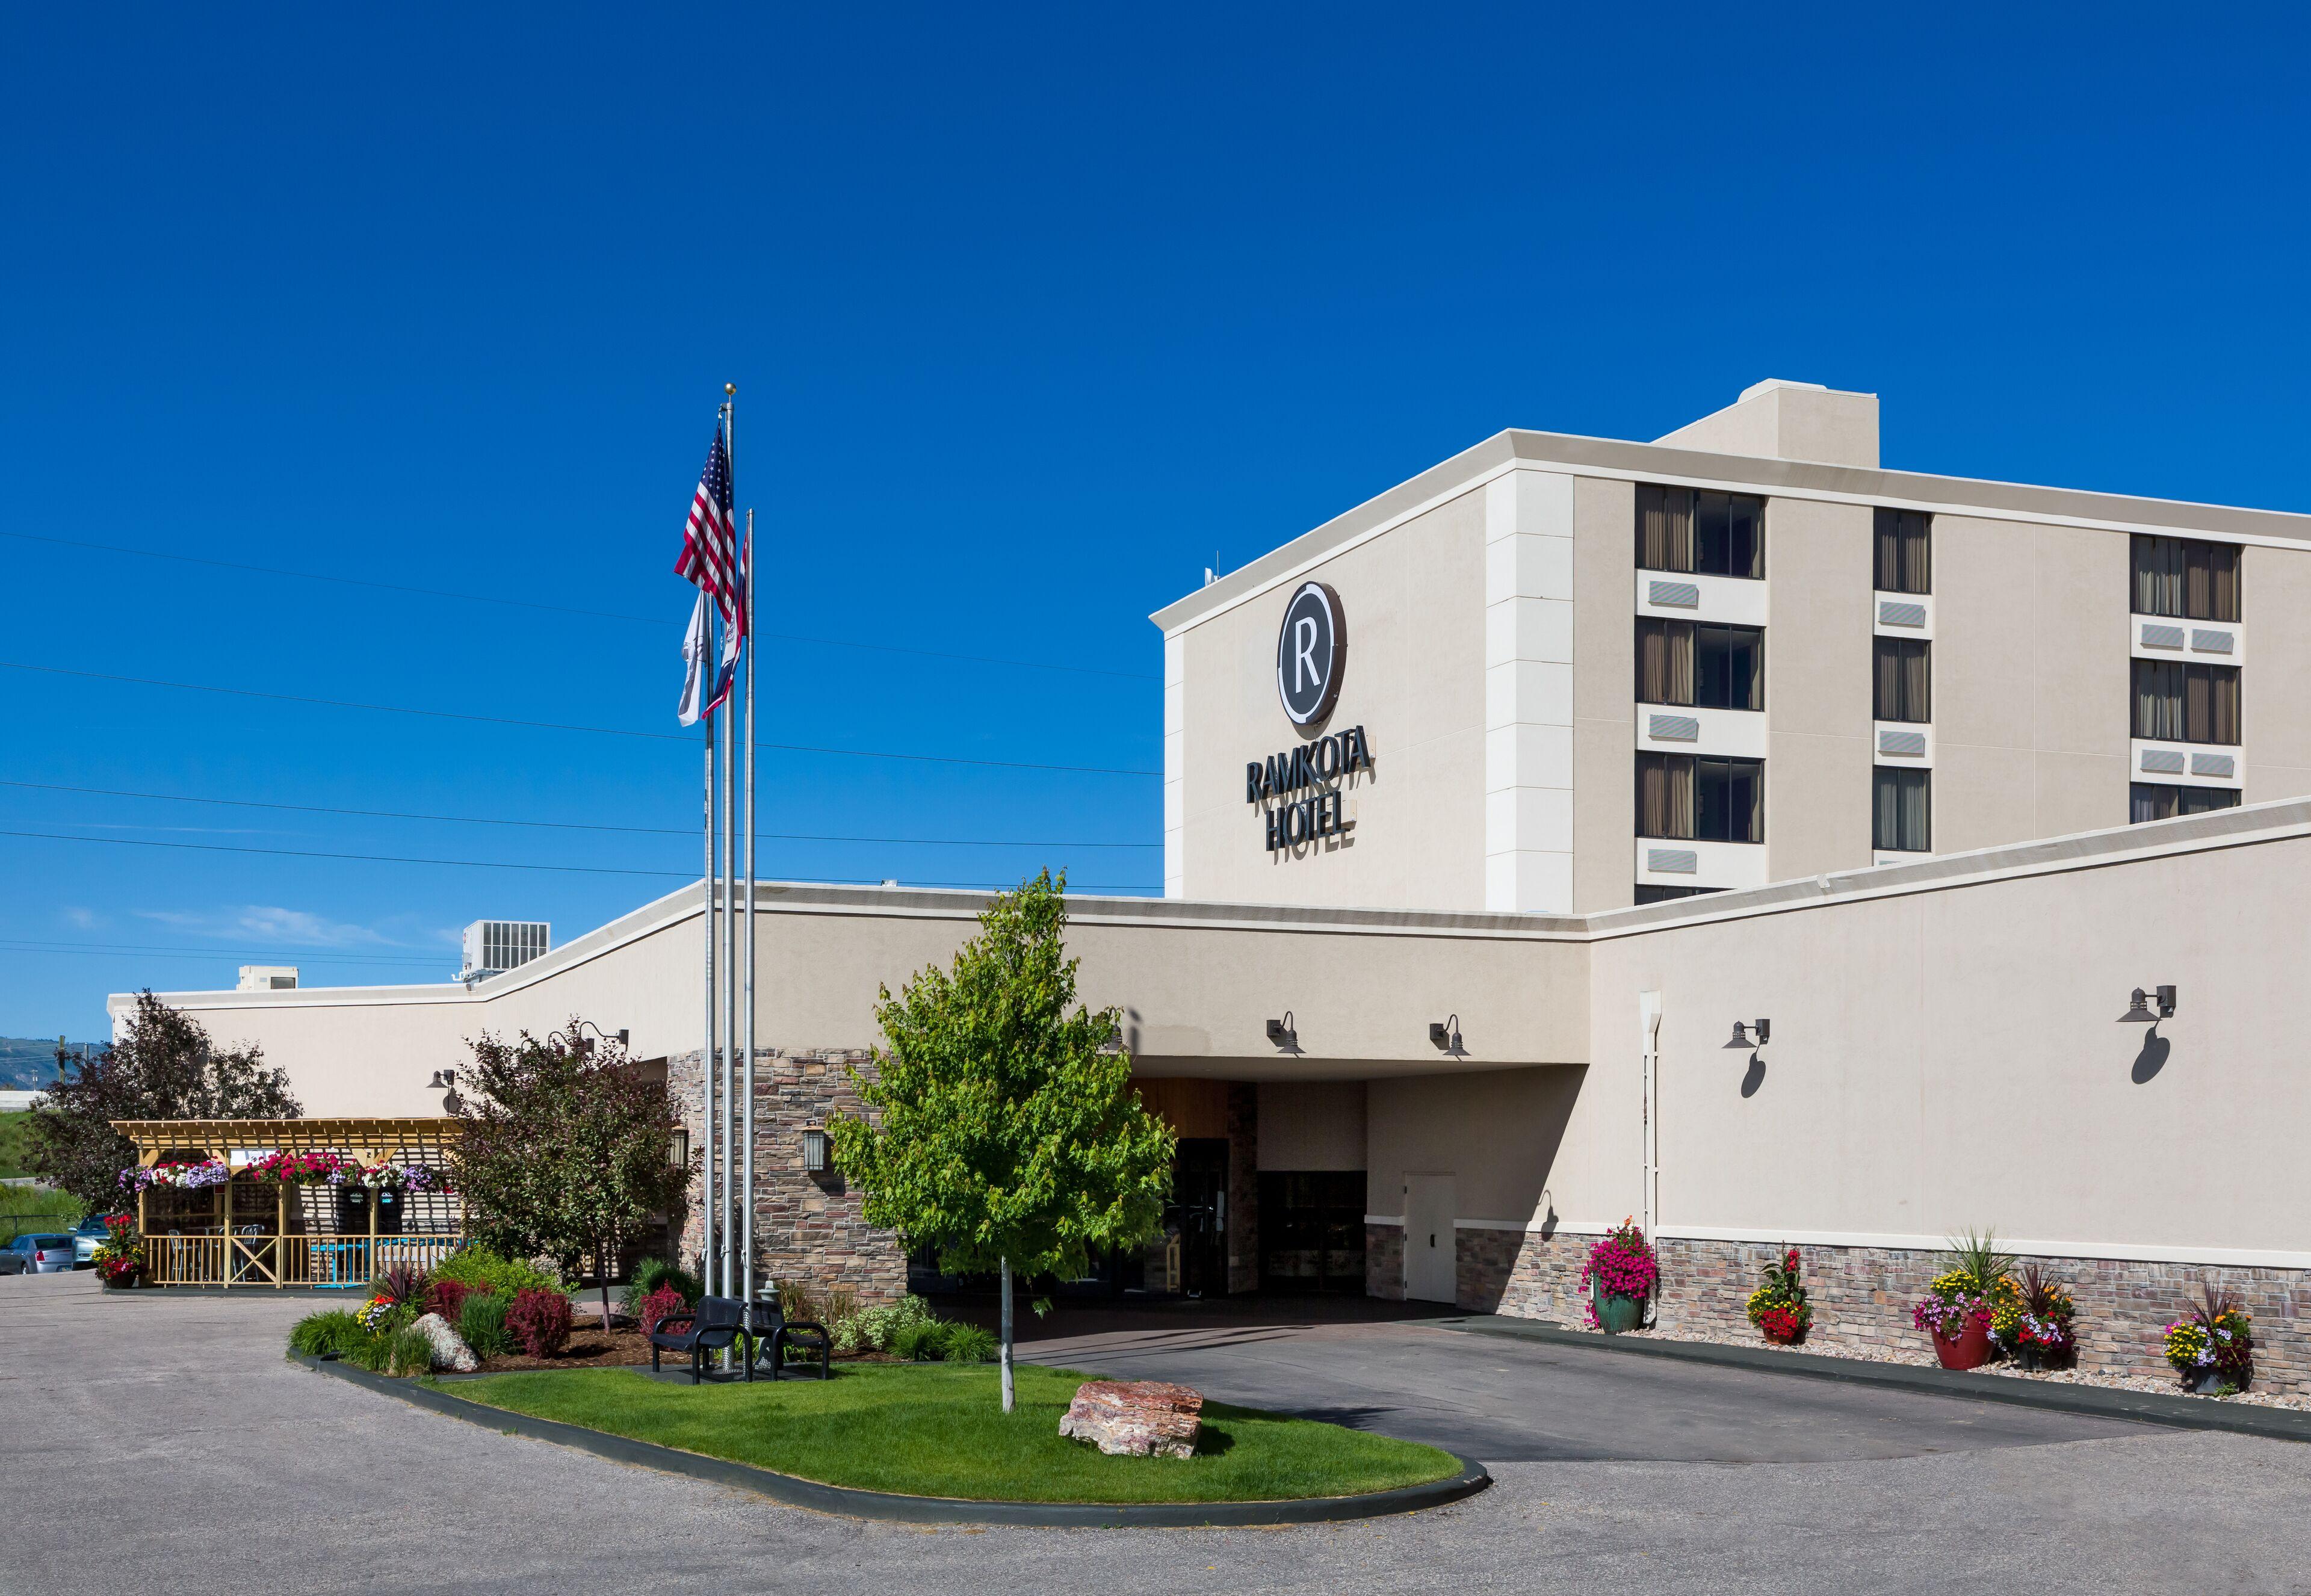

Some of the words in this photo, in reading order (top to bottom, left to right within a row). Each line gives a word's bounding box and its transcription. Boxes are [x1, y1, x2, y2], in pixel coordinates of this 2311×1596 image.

[1295, 616, 1320, 693] R
[1246, 725, 1372, 803] RAMKOTA
[1266, 791, 1350, 852] HOTEL
